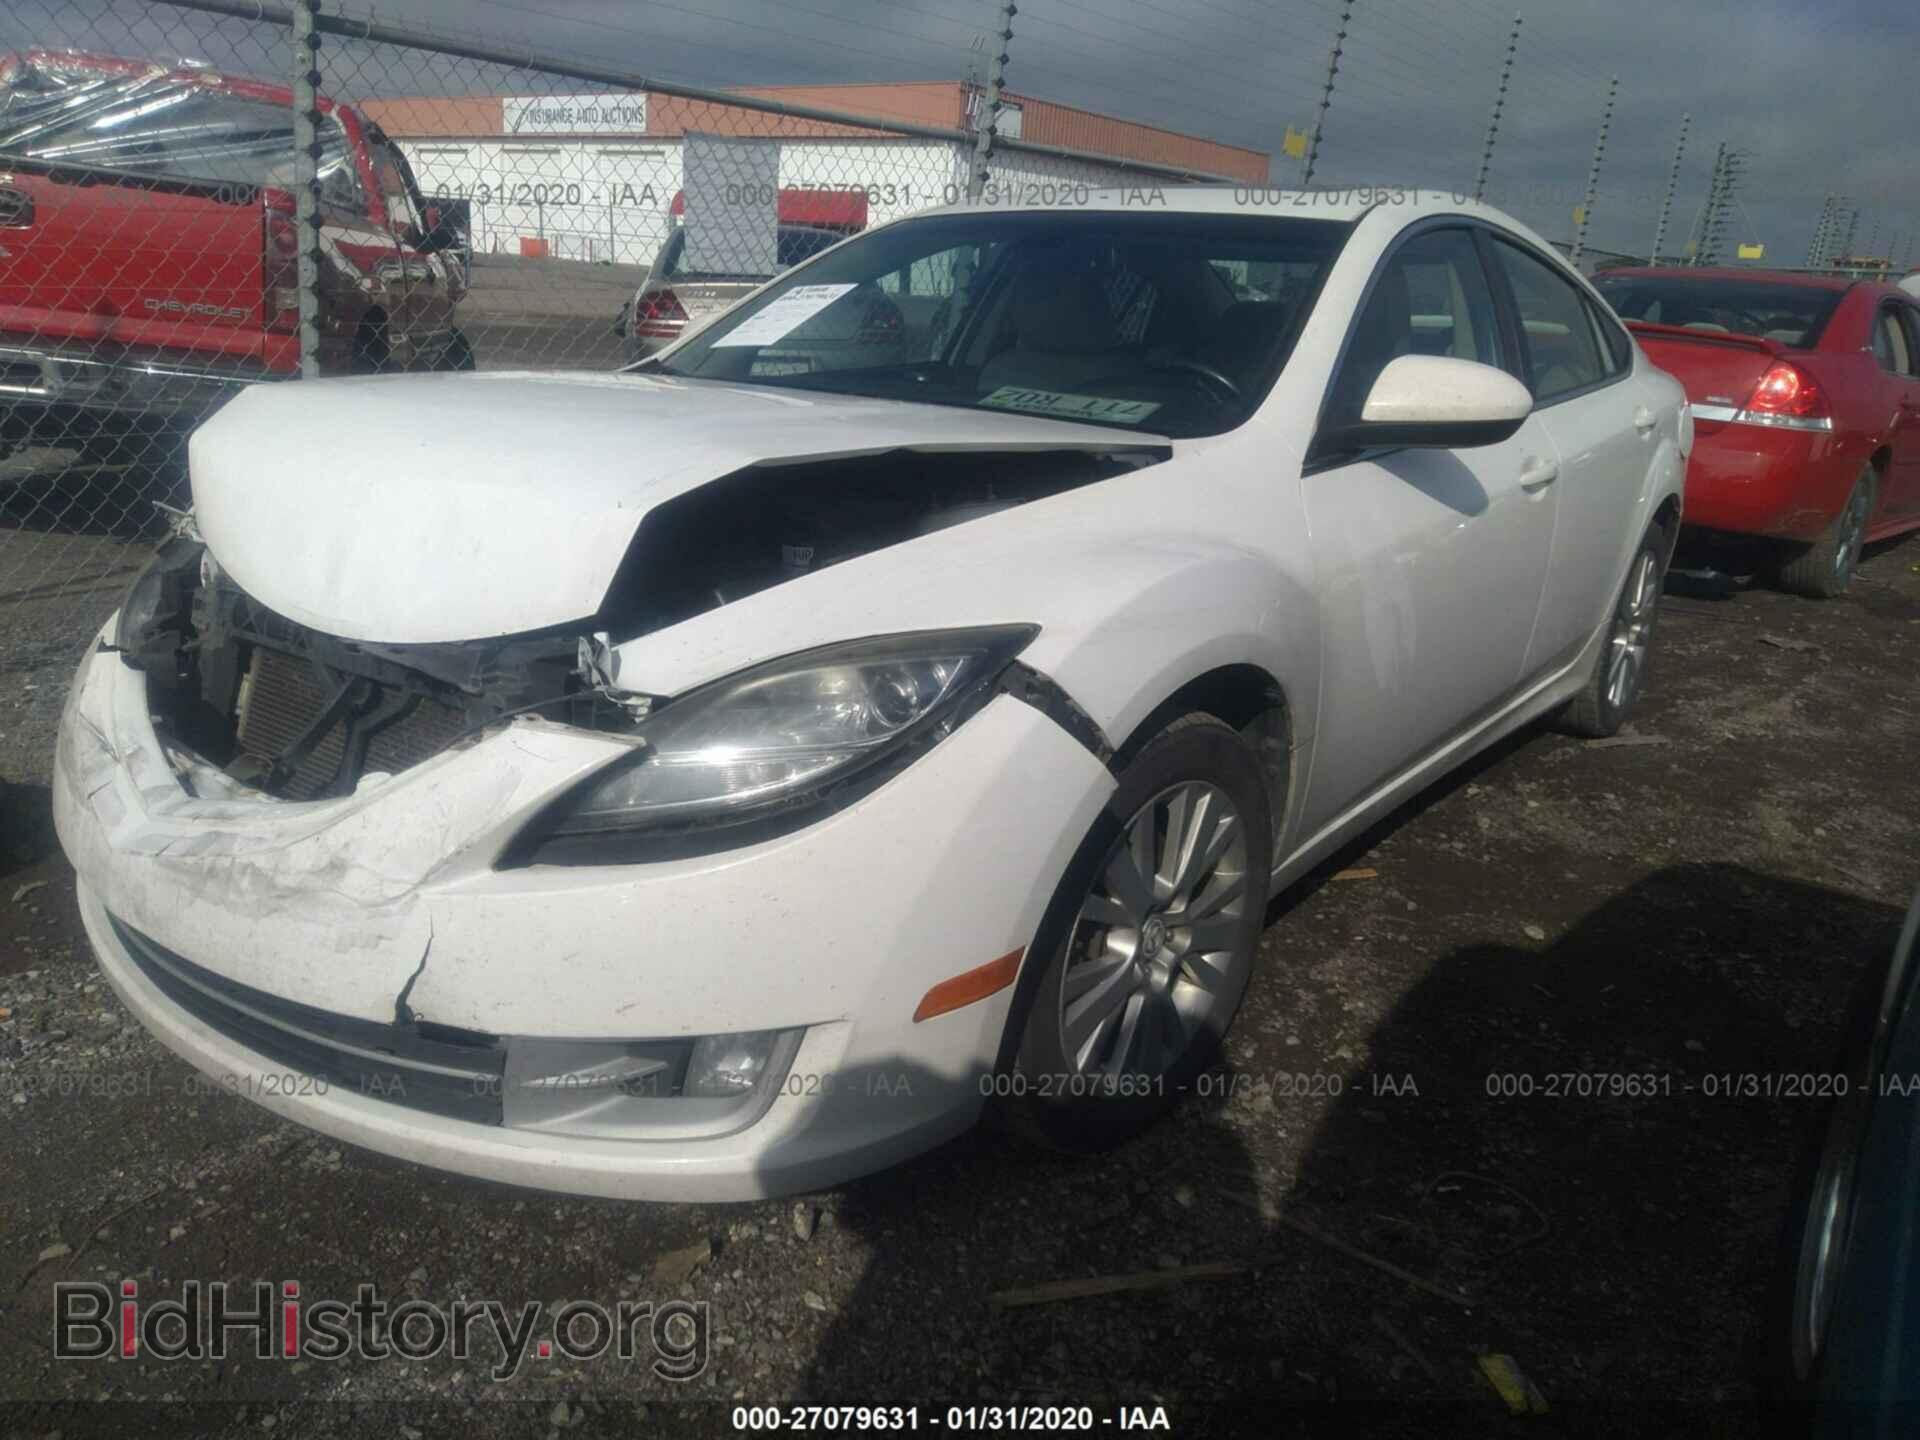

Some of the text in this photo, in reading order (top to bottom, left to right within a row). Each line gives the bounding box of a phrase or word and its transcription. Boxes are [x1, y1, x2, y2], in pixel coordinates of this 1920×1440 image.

[526, 105, 644, 125] INSURANCE AUTO AUCTIONS
